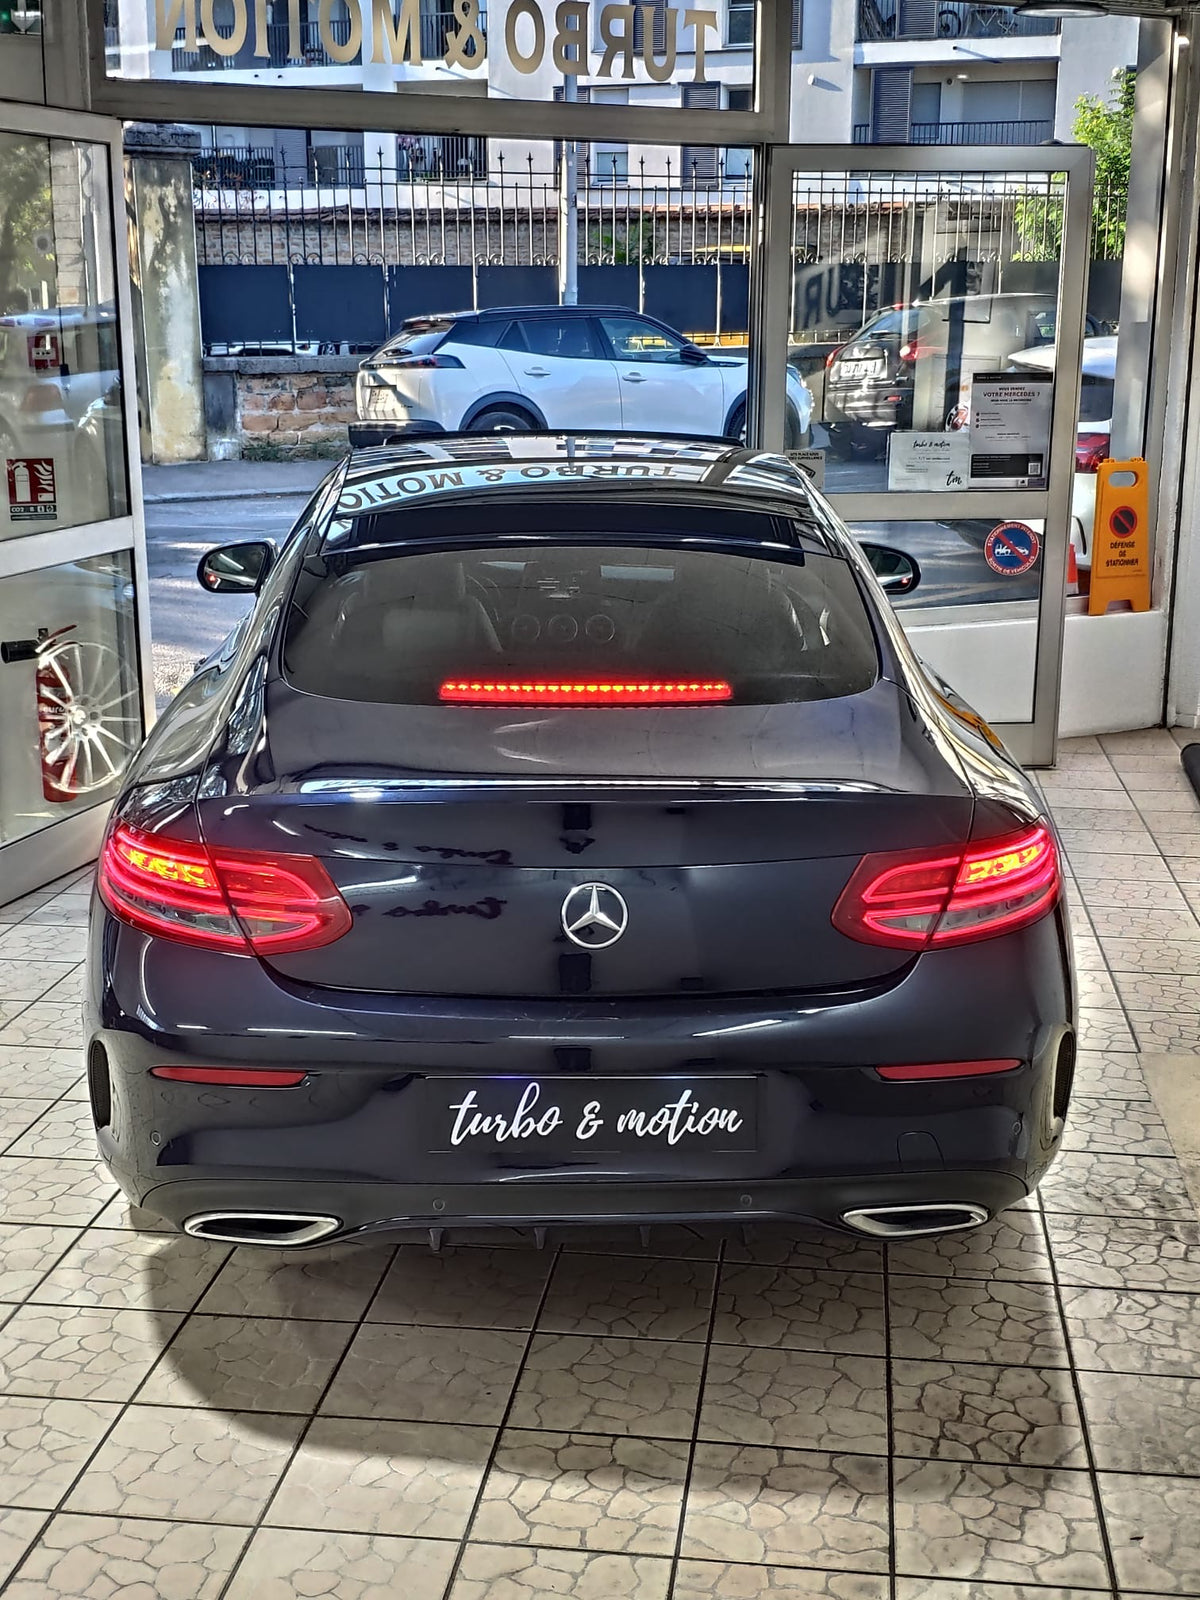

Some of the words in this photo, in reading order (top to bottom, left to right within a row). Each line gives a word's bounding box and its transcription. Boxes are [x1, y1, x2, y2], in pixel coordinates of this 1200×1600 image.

[449, 1082, 563, 1146] turbo
[576, 1100, 604, 1140] &
[617, 1089, 743, 1146] motion
